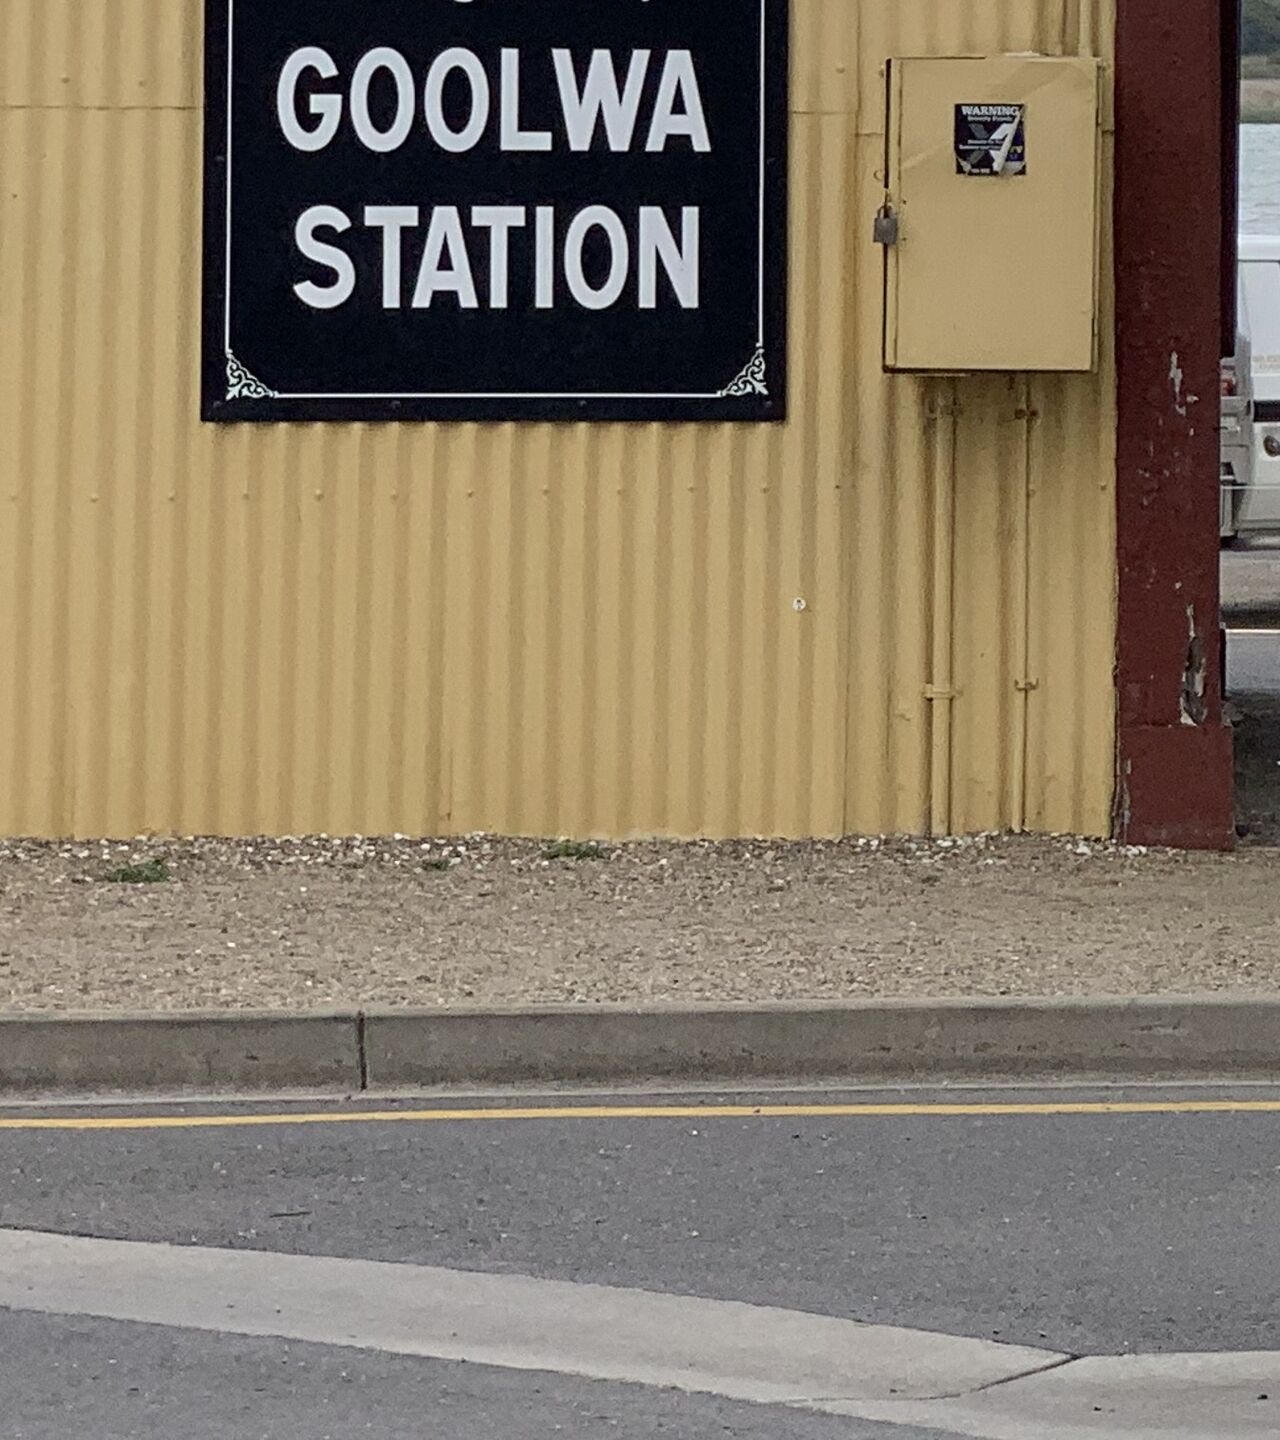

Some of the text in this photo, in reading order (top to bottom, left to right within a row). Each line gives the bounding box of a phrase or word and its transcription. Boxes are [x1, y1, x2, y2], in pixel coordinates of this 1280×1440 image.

[276, 46, 712, 153] GOOLWA
[961, 106, 1019, 116] WARNING
[293, 204, 700, 310] STATION
